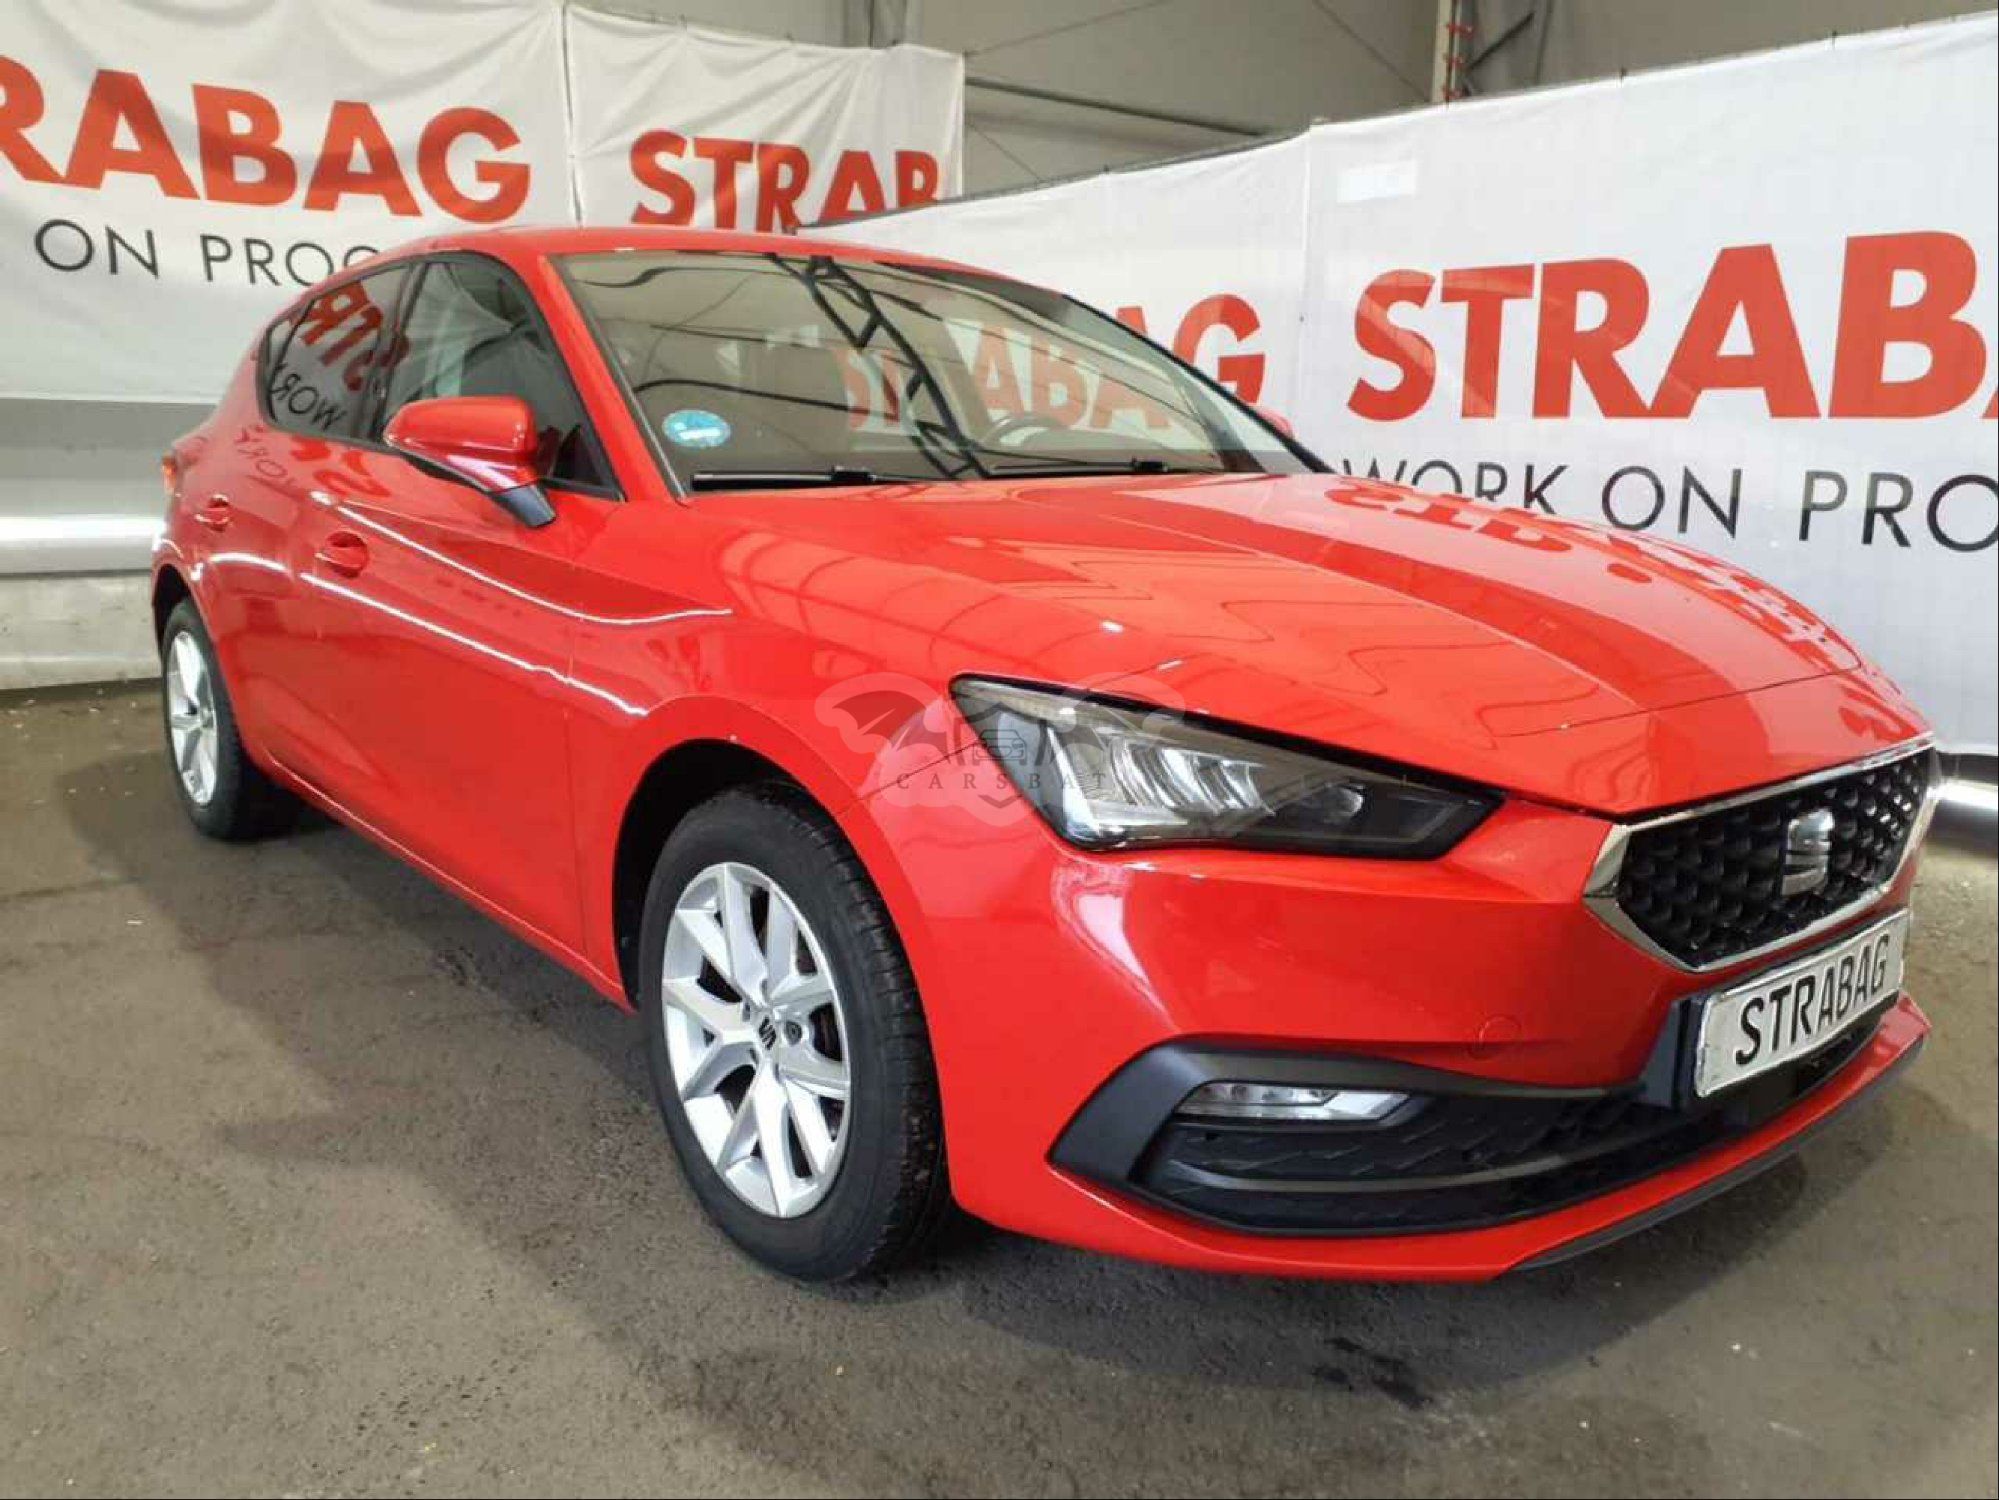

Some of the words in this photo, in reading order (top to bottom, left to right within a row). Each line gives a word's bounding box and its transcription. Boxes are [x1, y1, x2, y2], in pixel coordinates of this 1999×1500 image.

[35, 218, 160, 279] ON
[1347, 230, 1998, 421] STRAB
[1601, 465, 1742, 539] ON
[1799, 470, 1998, 552] PRO
[1734, 933, 1890, 1065] STRABAG
